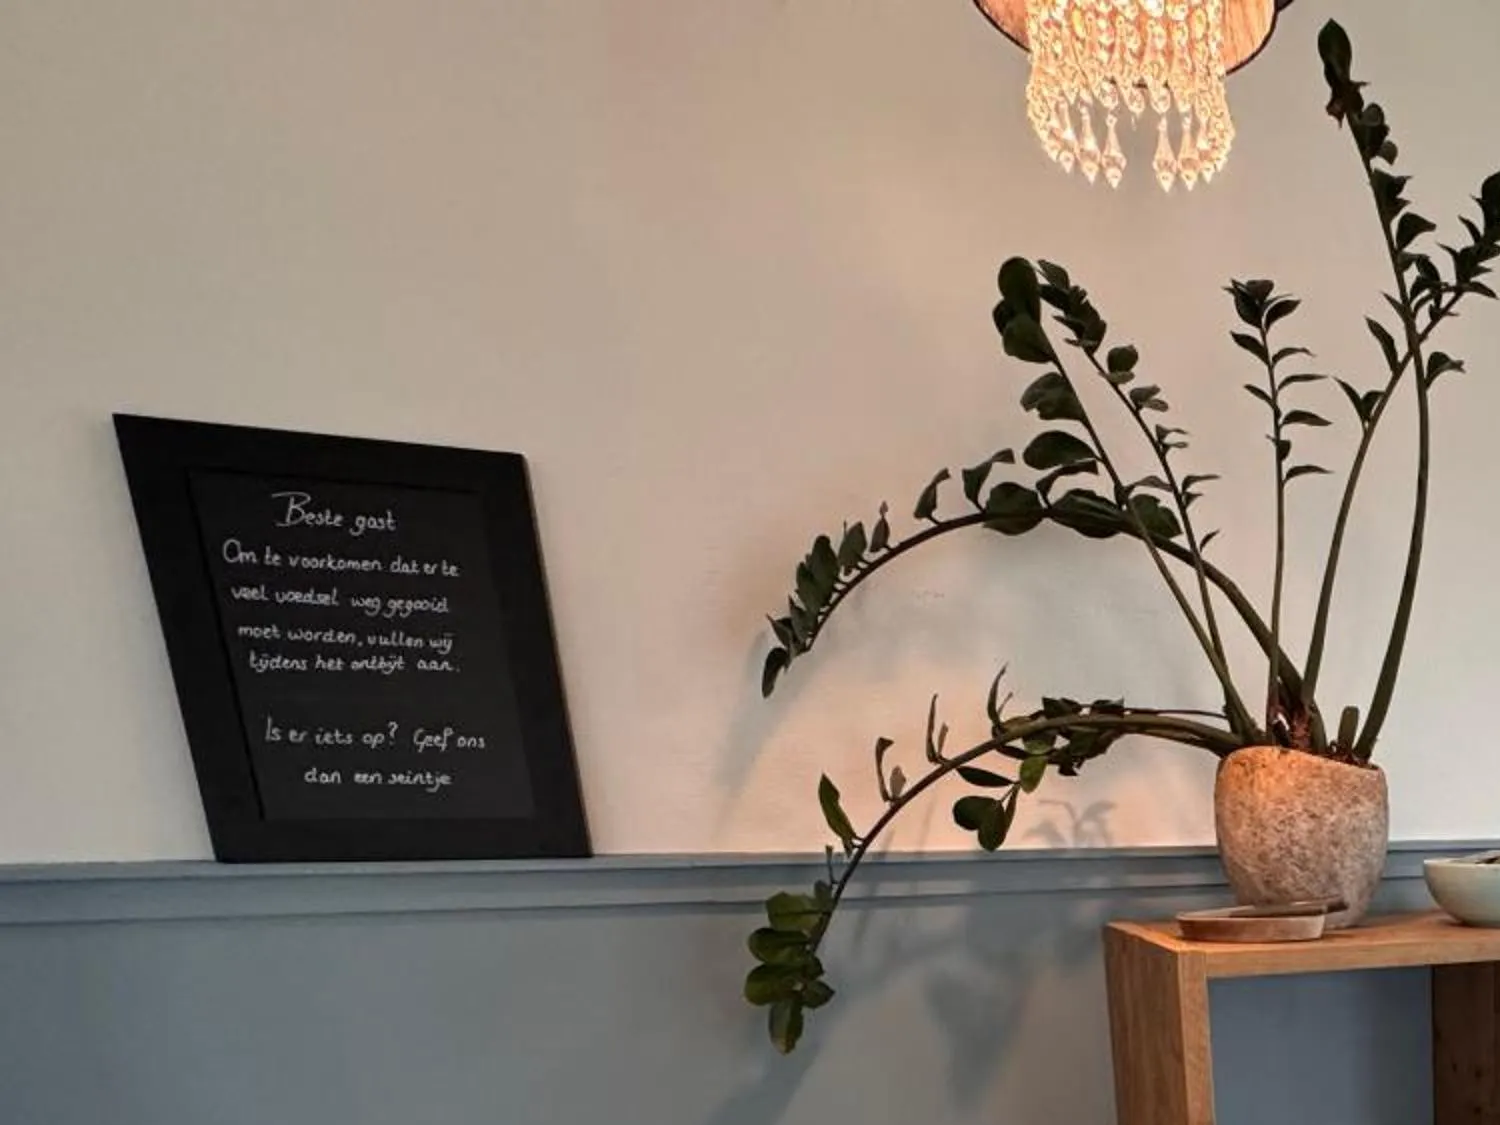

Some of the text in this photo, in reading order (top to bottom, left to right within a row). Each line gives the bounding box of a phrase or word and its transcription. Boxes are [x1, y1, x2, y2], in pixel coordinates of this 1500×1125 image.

[271, 491, 397, 536] Beste gast
[222, 538, 460, 577] Om te voorkomen dat er te
[231, 584, 268, 600] veel
[275, 587, 339, 606] voedsel
[238, 624, 280, 639] moet
[367, 630, 424, 648] vullen
[315, 656, 345, 671] het
[265, 714, 486, 753] Is er iets op? Geef ons
[304, 767, 453, 793] dan een seintje
